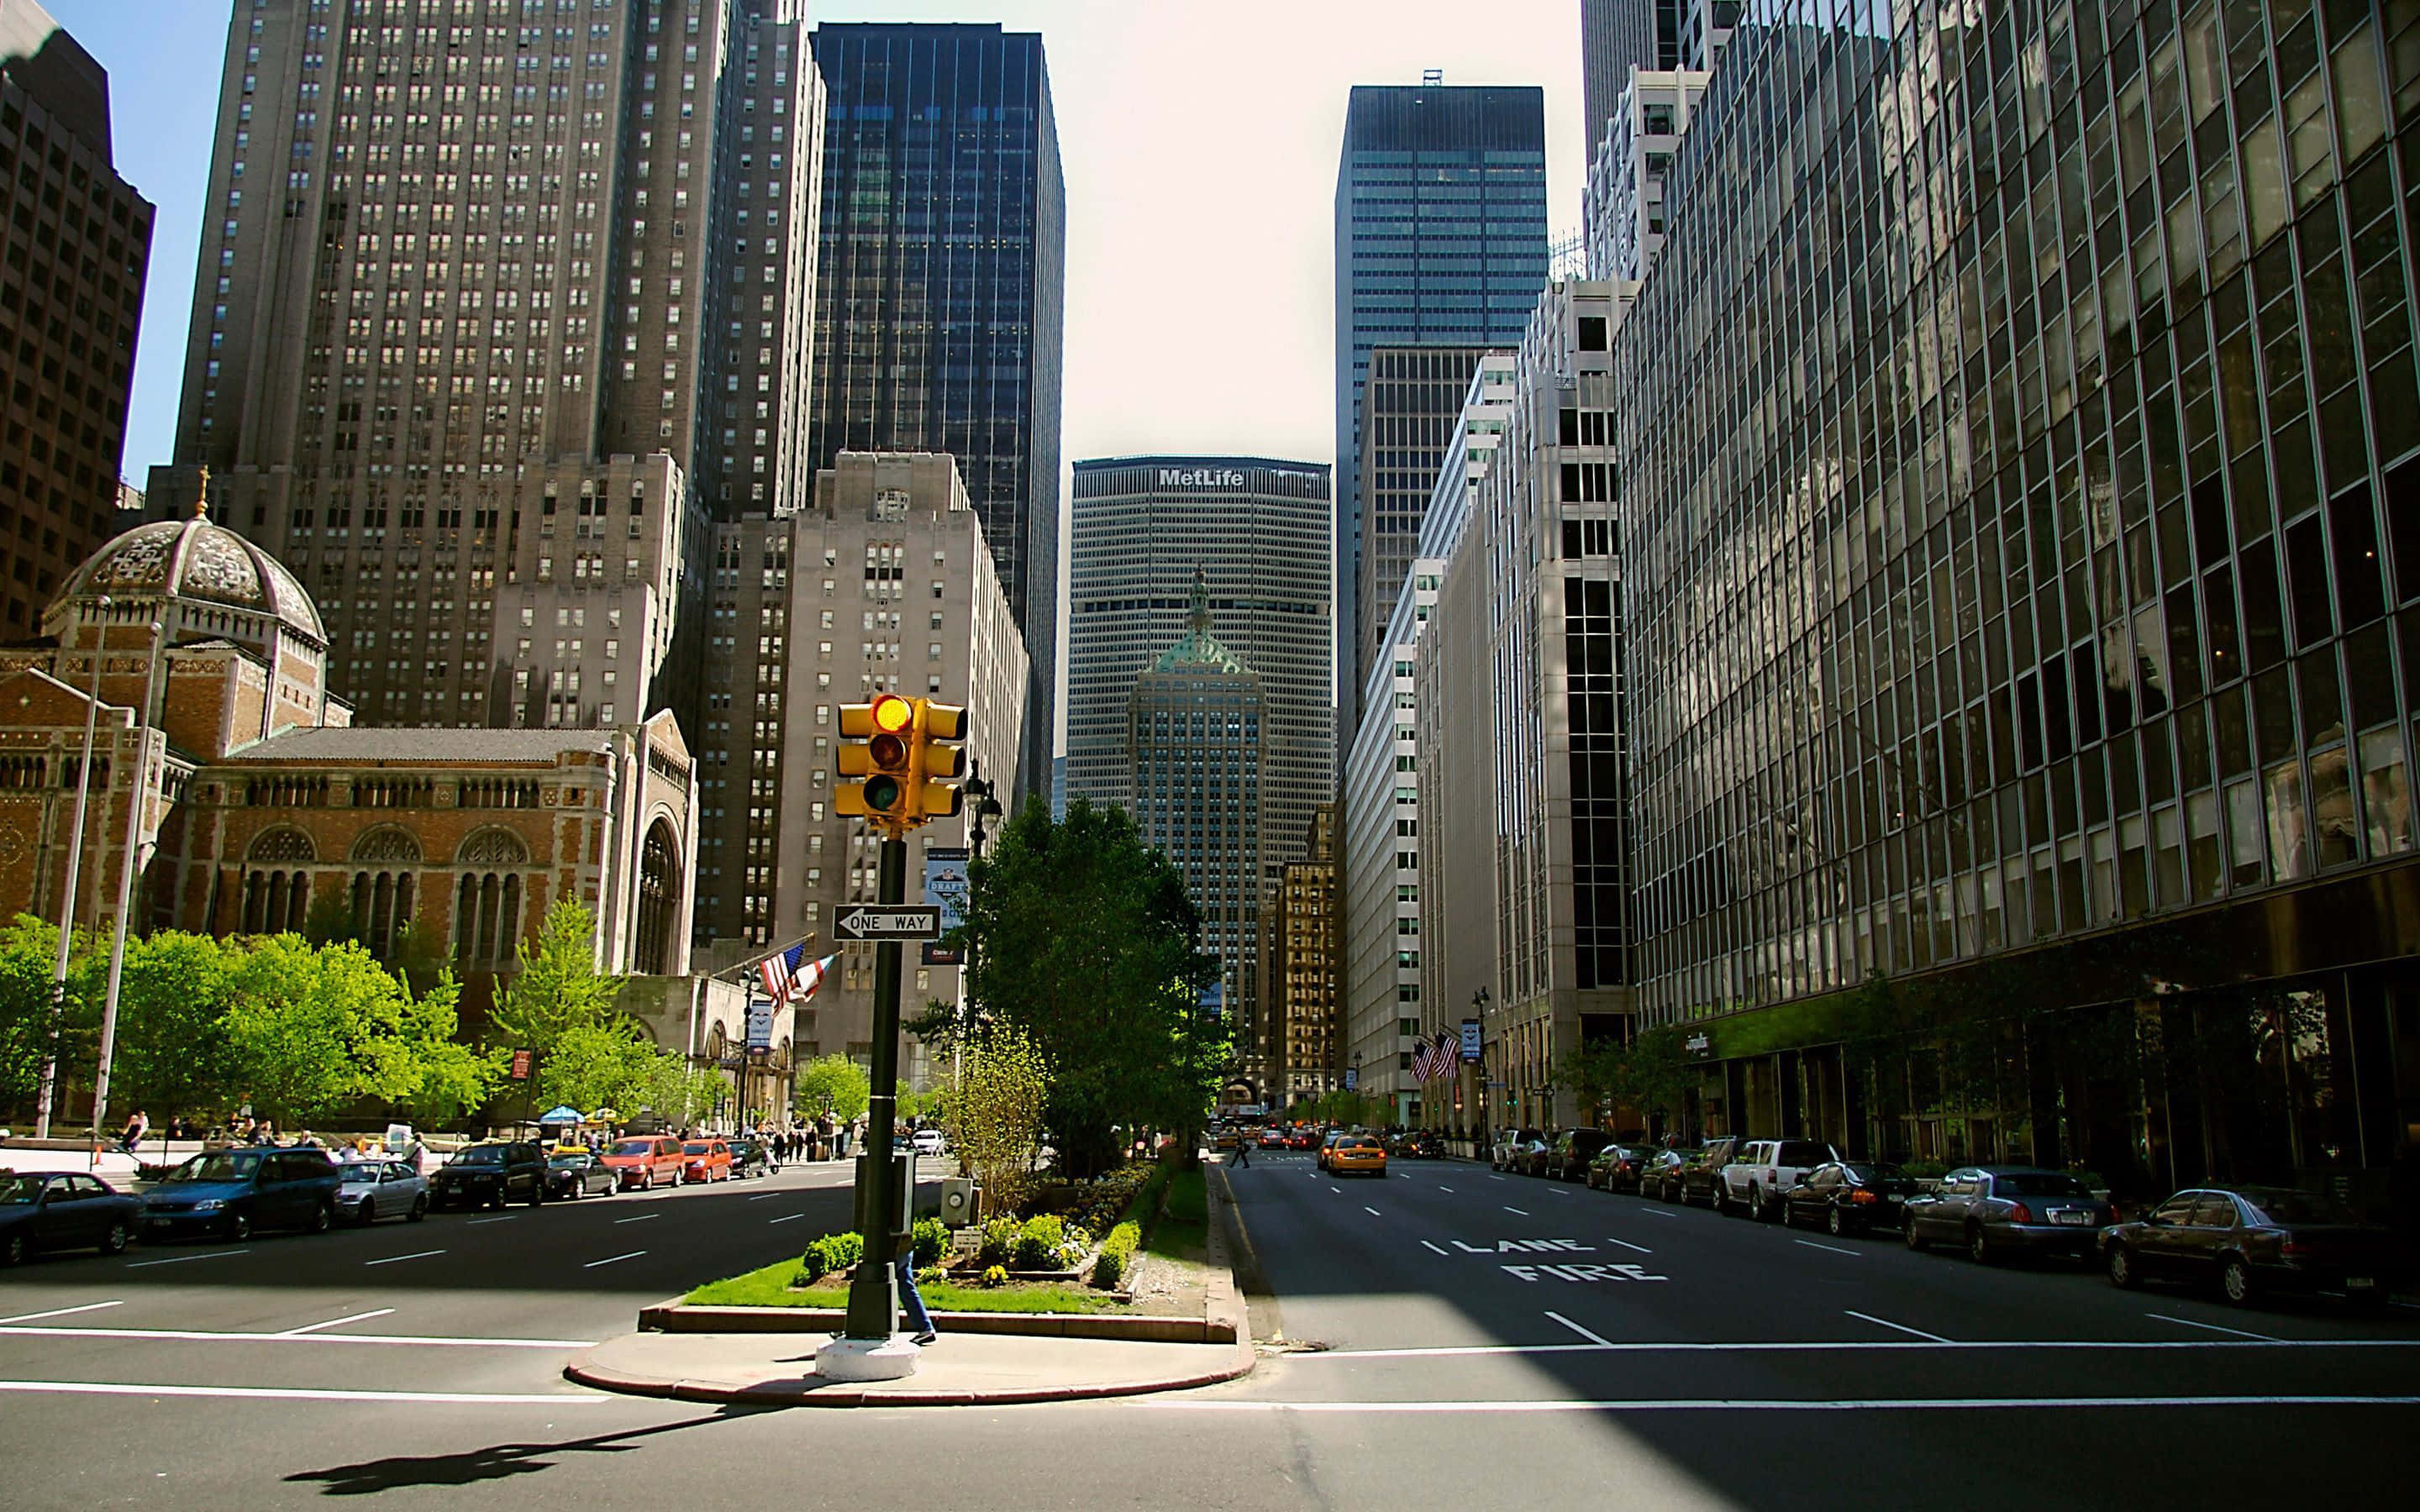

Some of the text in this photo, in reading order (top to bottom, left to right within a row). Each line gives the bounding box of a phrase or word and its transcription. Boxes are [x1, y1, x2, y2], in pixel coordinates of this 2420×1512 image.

[1160, 470, 1244, 486] MetLife
[930, 882, 964, 890] DRAFT
[850, 916, 926, 929] ONE WAY
[1450, 1240, 1597, 1252] LANE
[1500, 1264, 1670, 1281] FIRE
